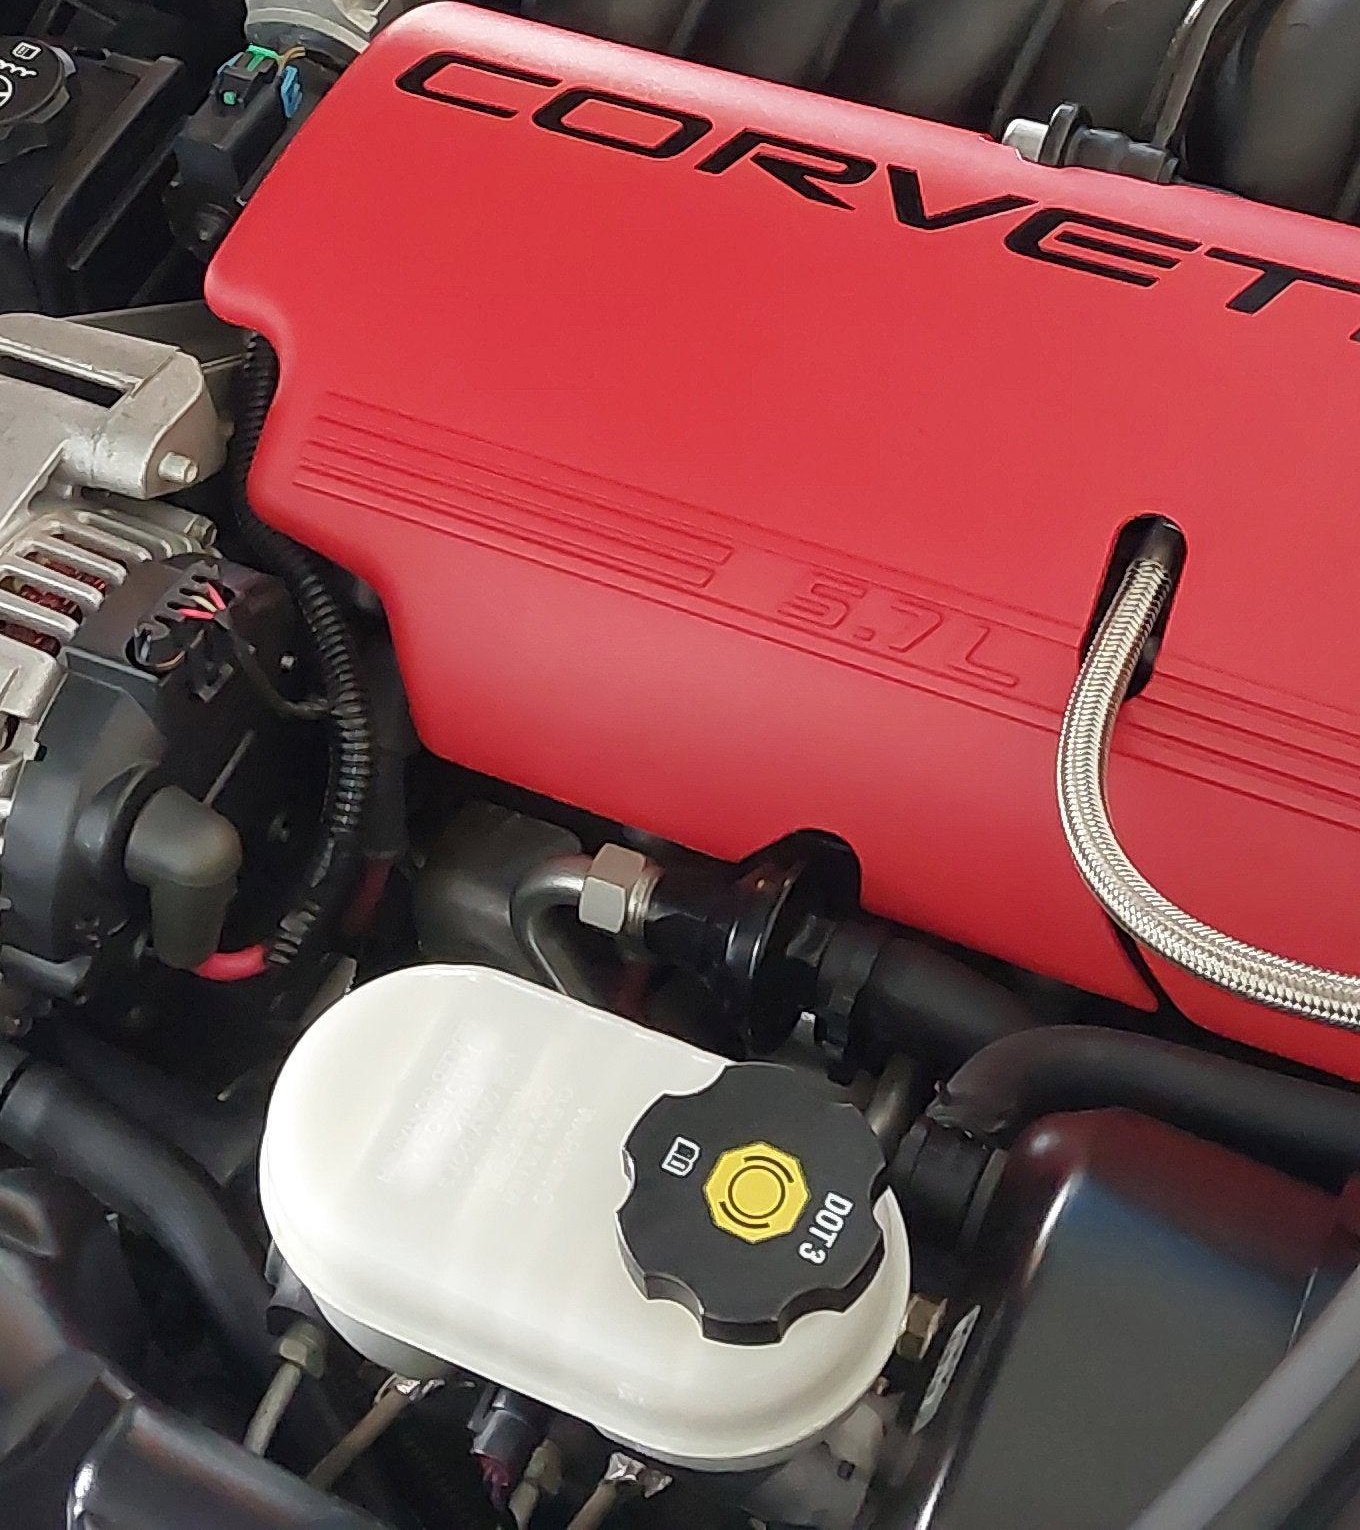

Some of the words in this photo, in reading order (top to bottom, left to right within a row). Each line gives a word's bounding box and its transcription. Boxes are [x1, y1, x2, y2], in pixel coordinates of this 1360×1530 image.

[778, 568, 1019, 687] 5.7L
[809, 1192, 853, 1248] DOT
[799, 1242, 826, 1264] 3
